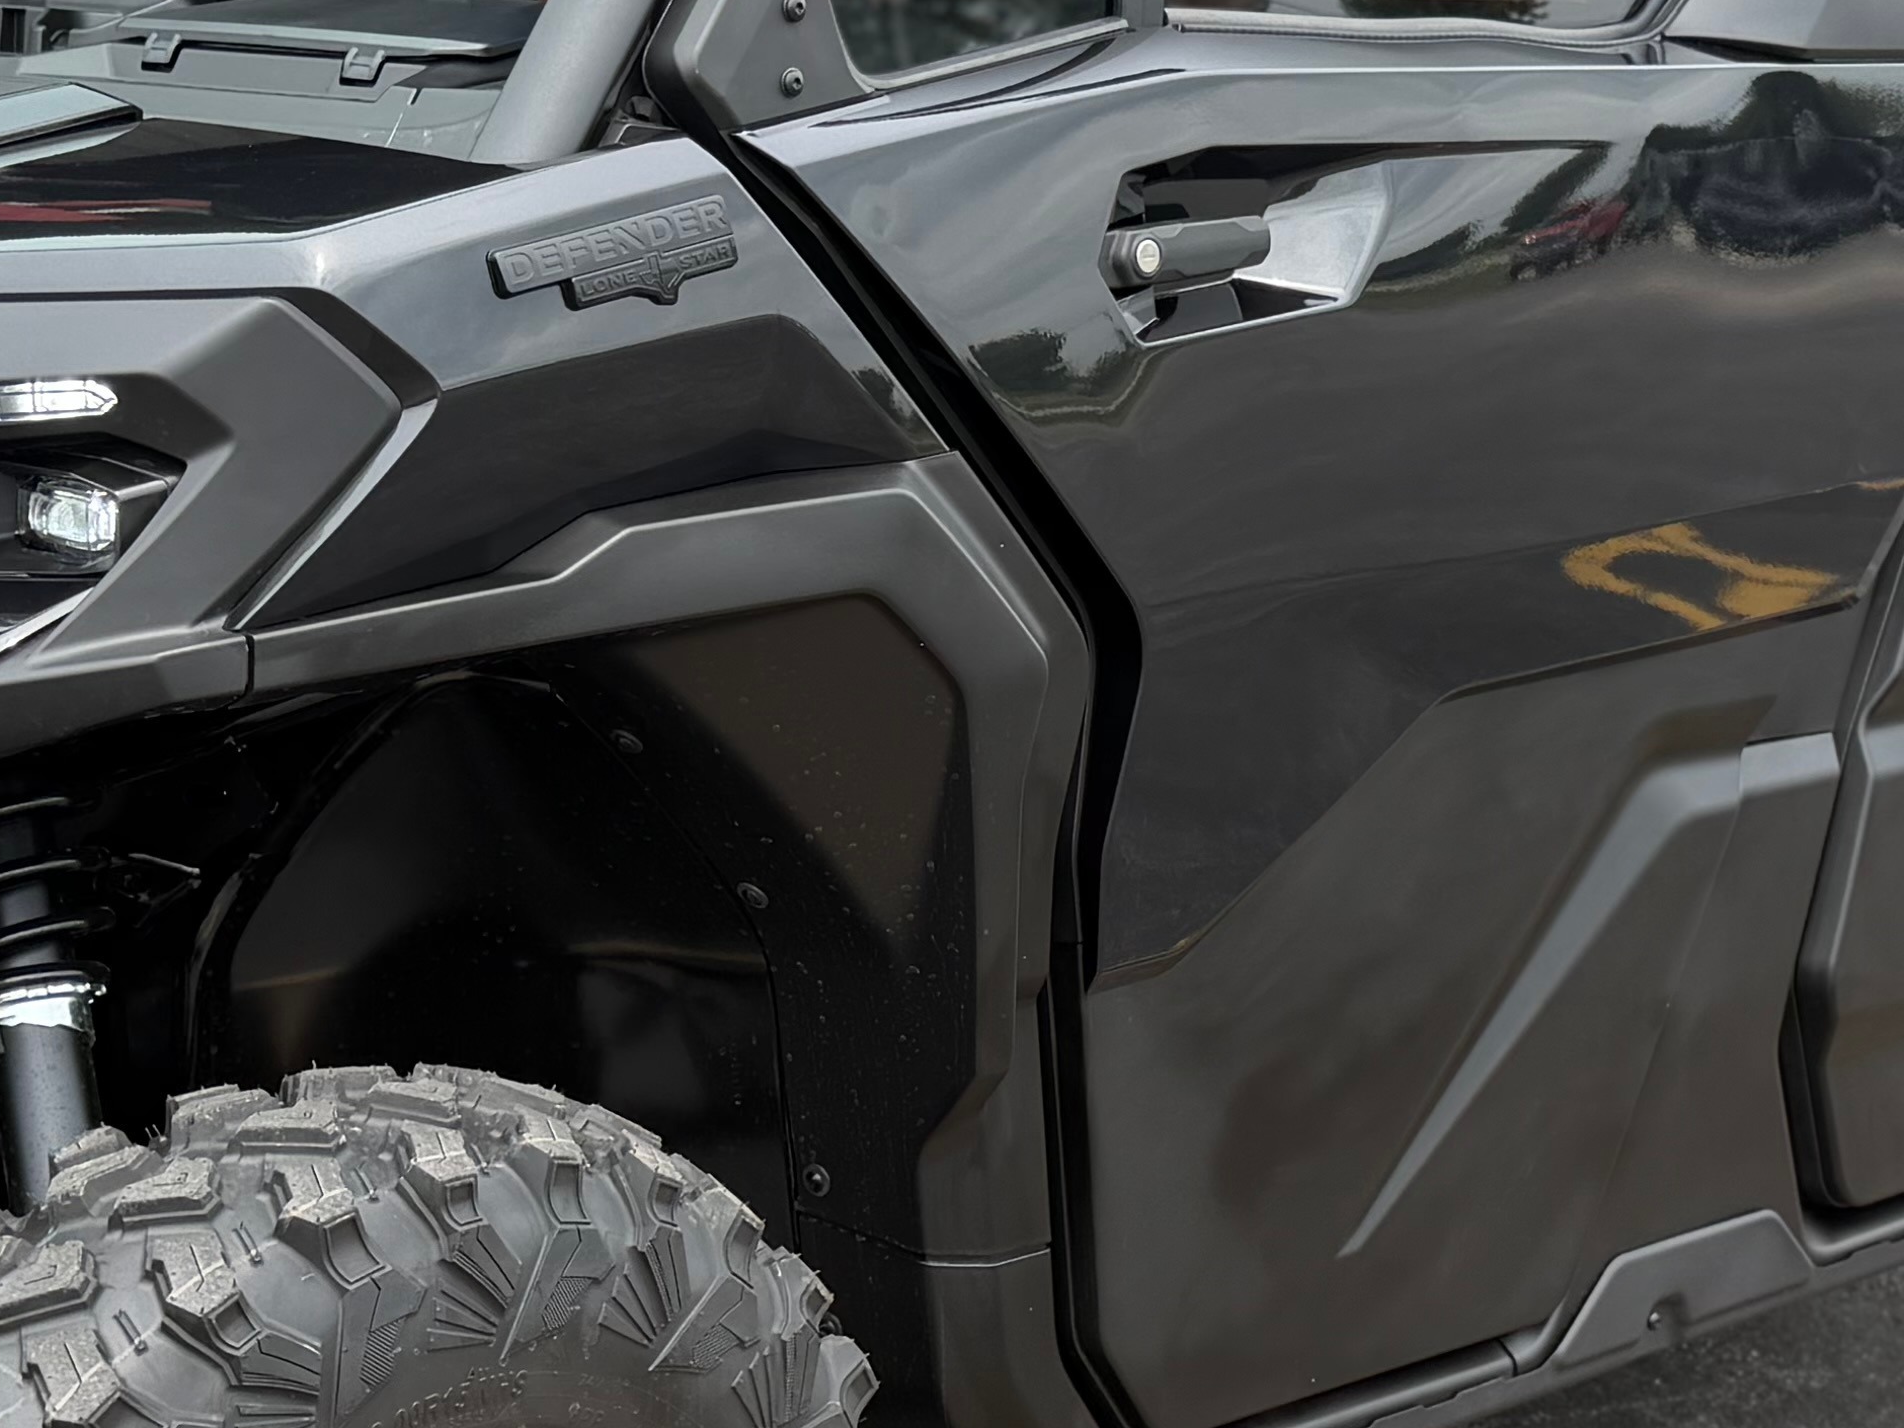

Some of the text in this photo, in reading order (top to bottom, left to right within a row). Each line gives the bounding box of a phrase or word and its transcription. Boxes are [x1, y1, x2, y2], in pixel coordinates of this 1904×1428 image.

[504, 201, 728, 284] DEFENDER
[580, 244, 732, 296] LONE STAR
